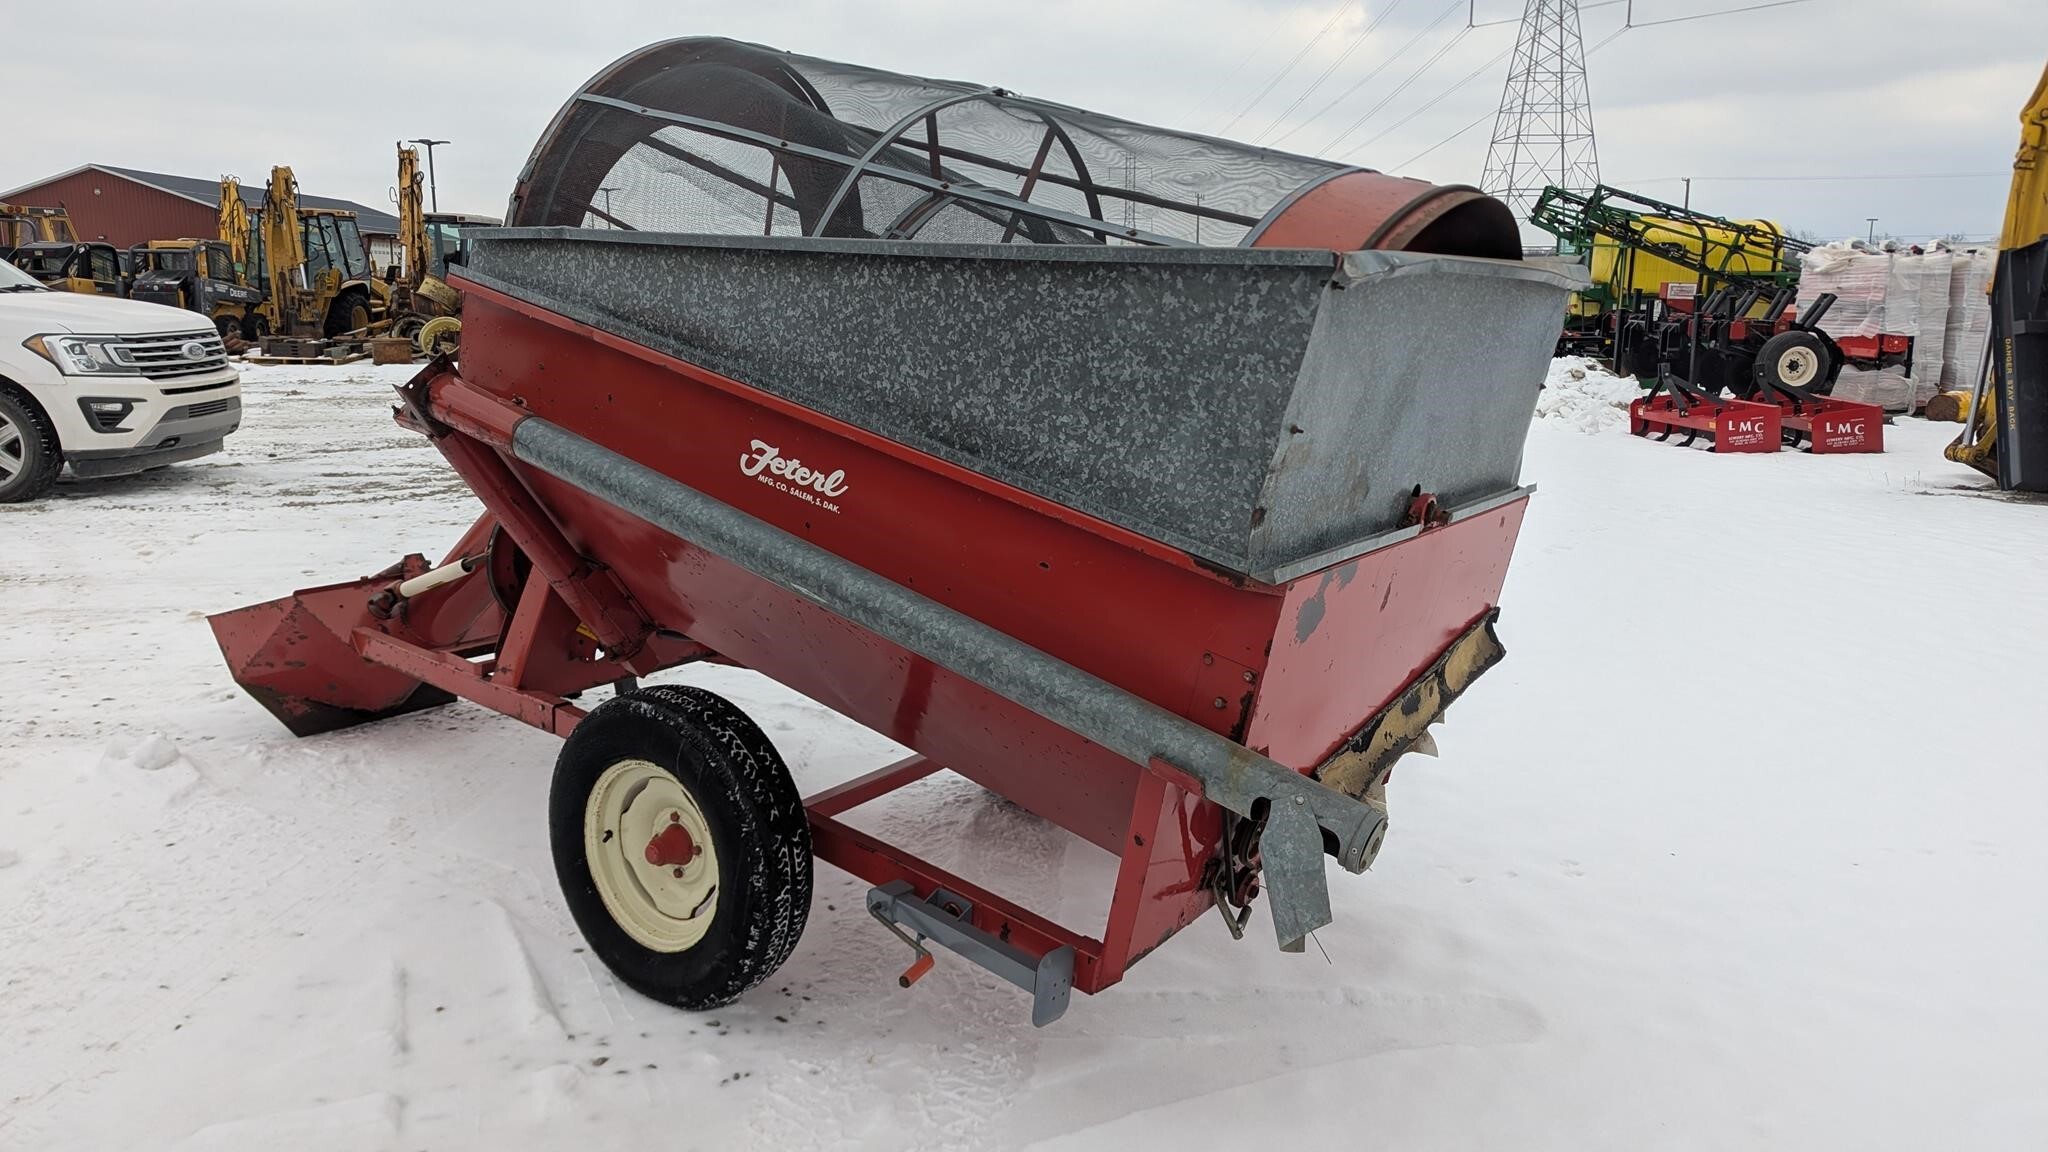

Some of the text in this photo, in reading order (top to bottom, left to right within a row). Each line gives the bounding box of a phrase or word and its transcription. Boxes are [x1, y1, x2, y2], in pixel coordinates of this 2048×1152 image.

[2005, 338, 2016, 431] DANGER STAY BACK
[740, 439, 849, 497] Feterl
[757, 474, 840, 514] MFG. CO. SALEM, S. DAK.
